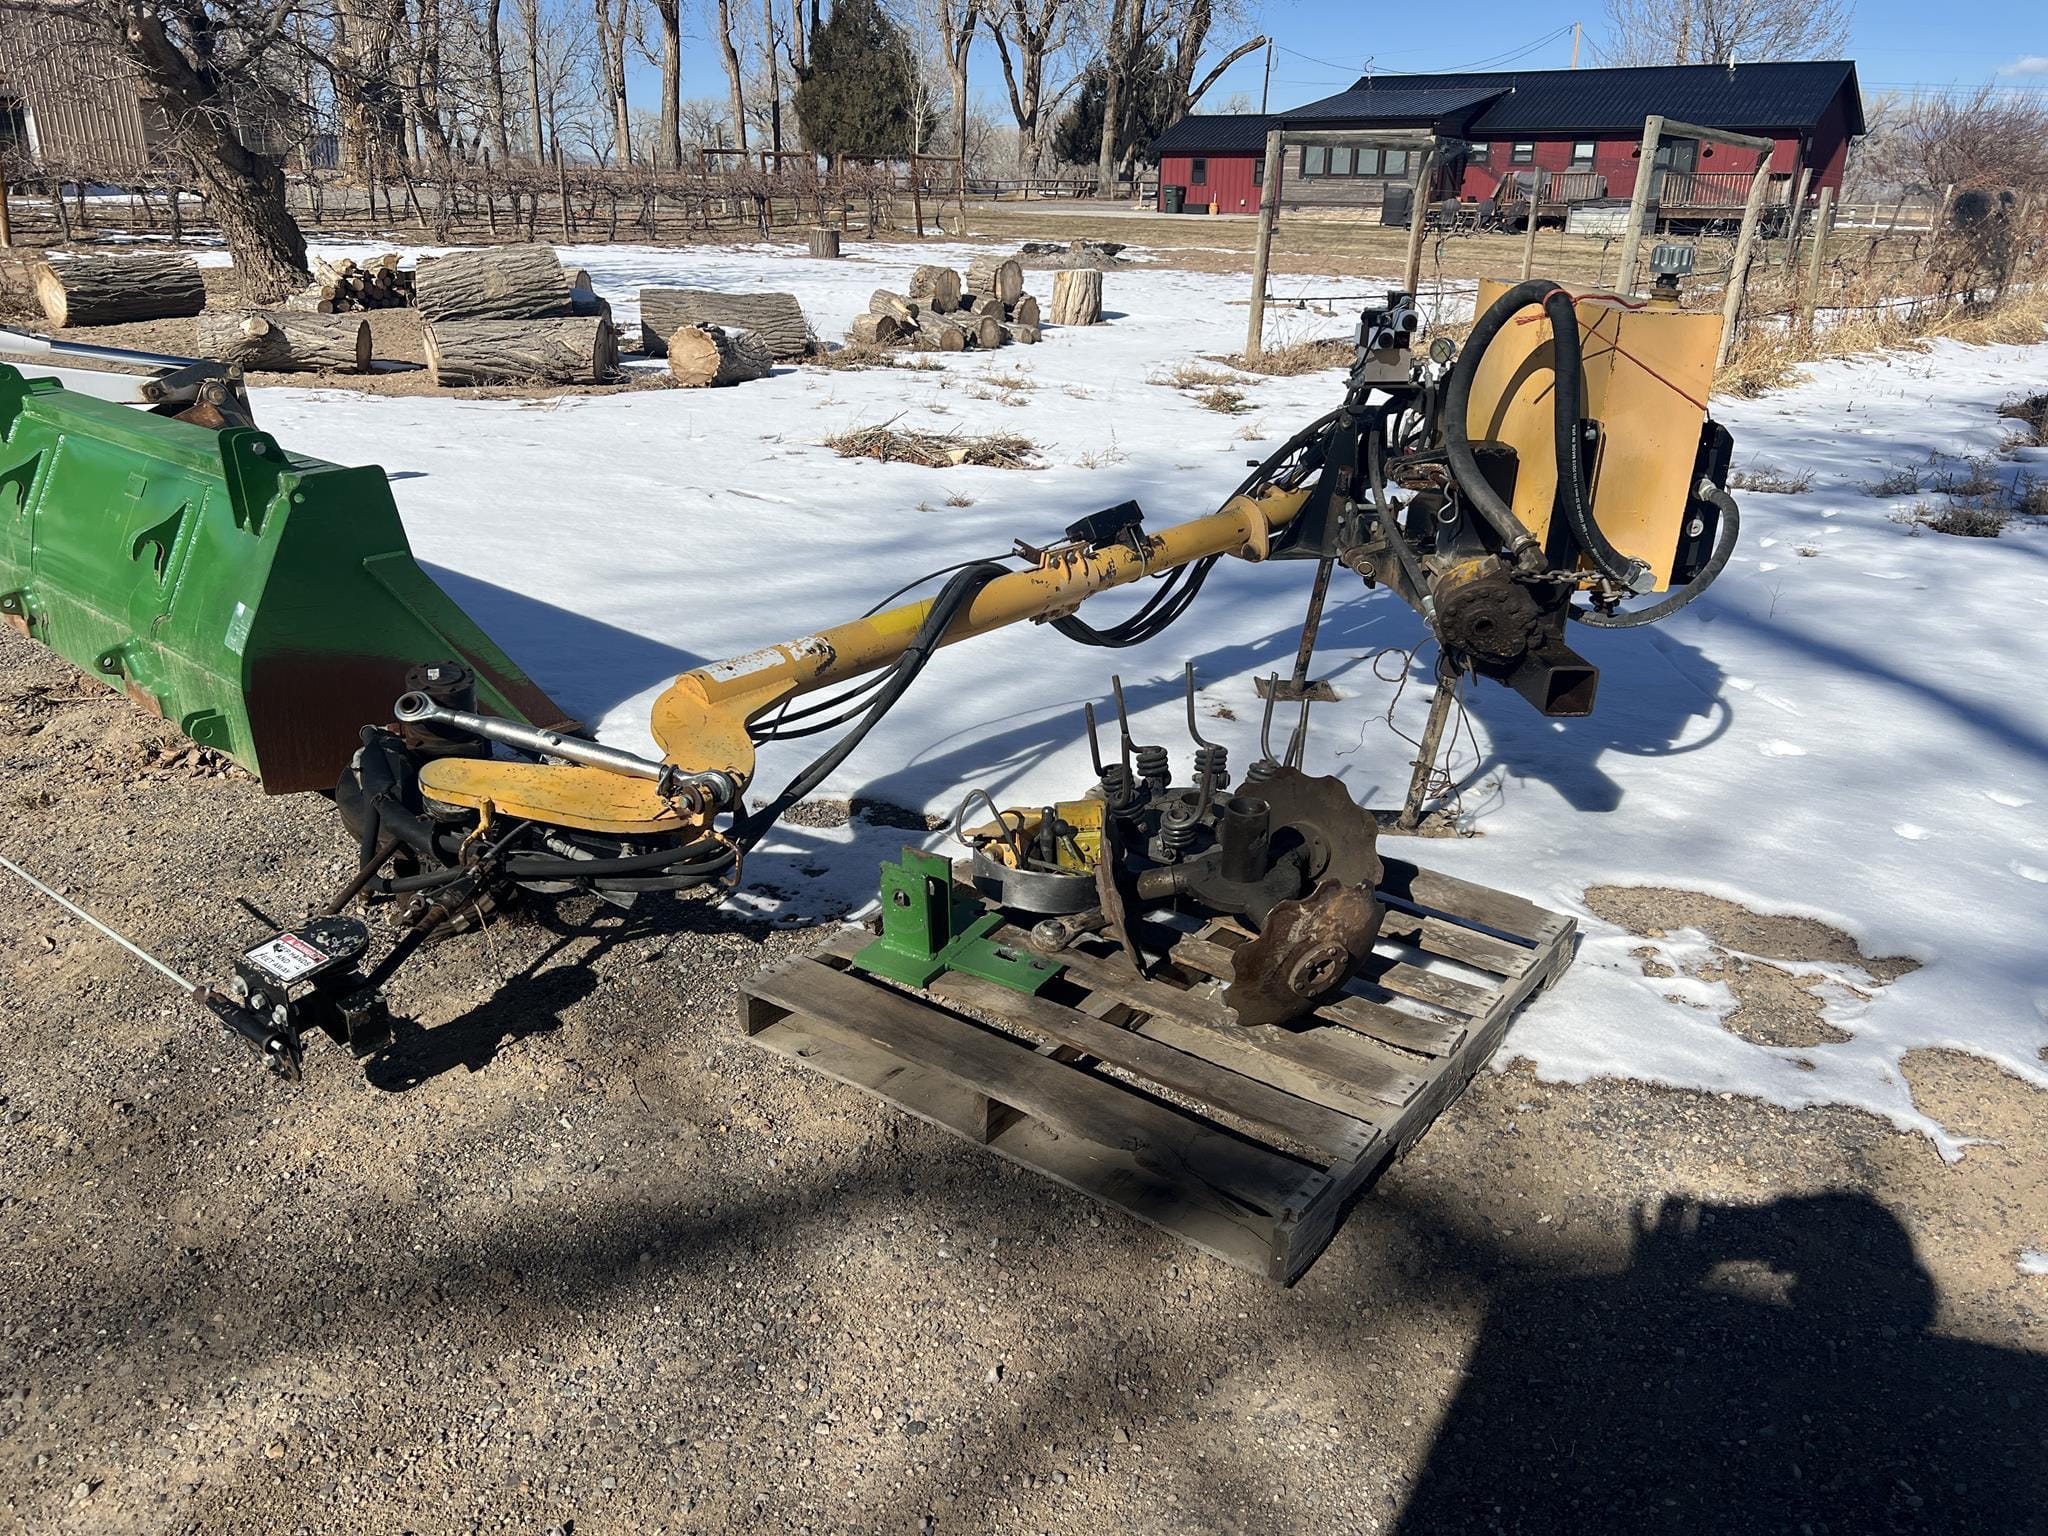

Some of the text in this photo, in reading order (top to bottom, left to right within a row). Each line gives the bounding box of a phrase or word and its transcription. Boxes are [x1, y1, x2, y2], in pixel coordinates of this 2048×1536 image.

[275, 954, 290, 963] AND
[290, 951, 312, 966] HANDS
[271, 962, 291, 973] AWAY
